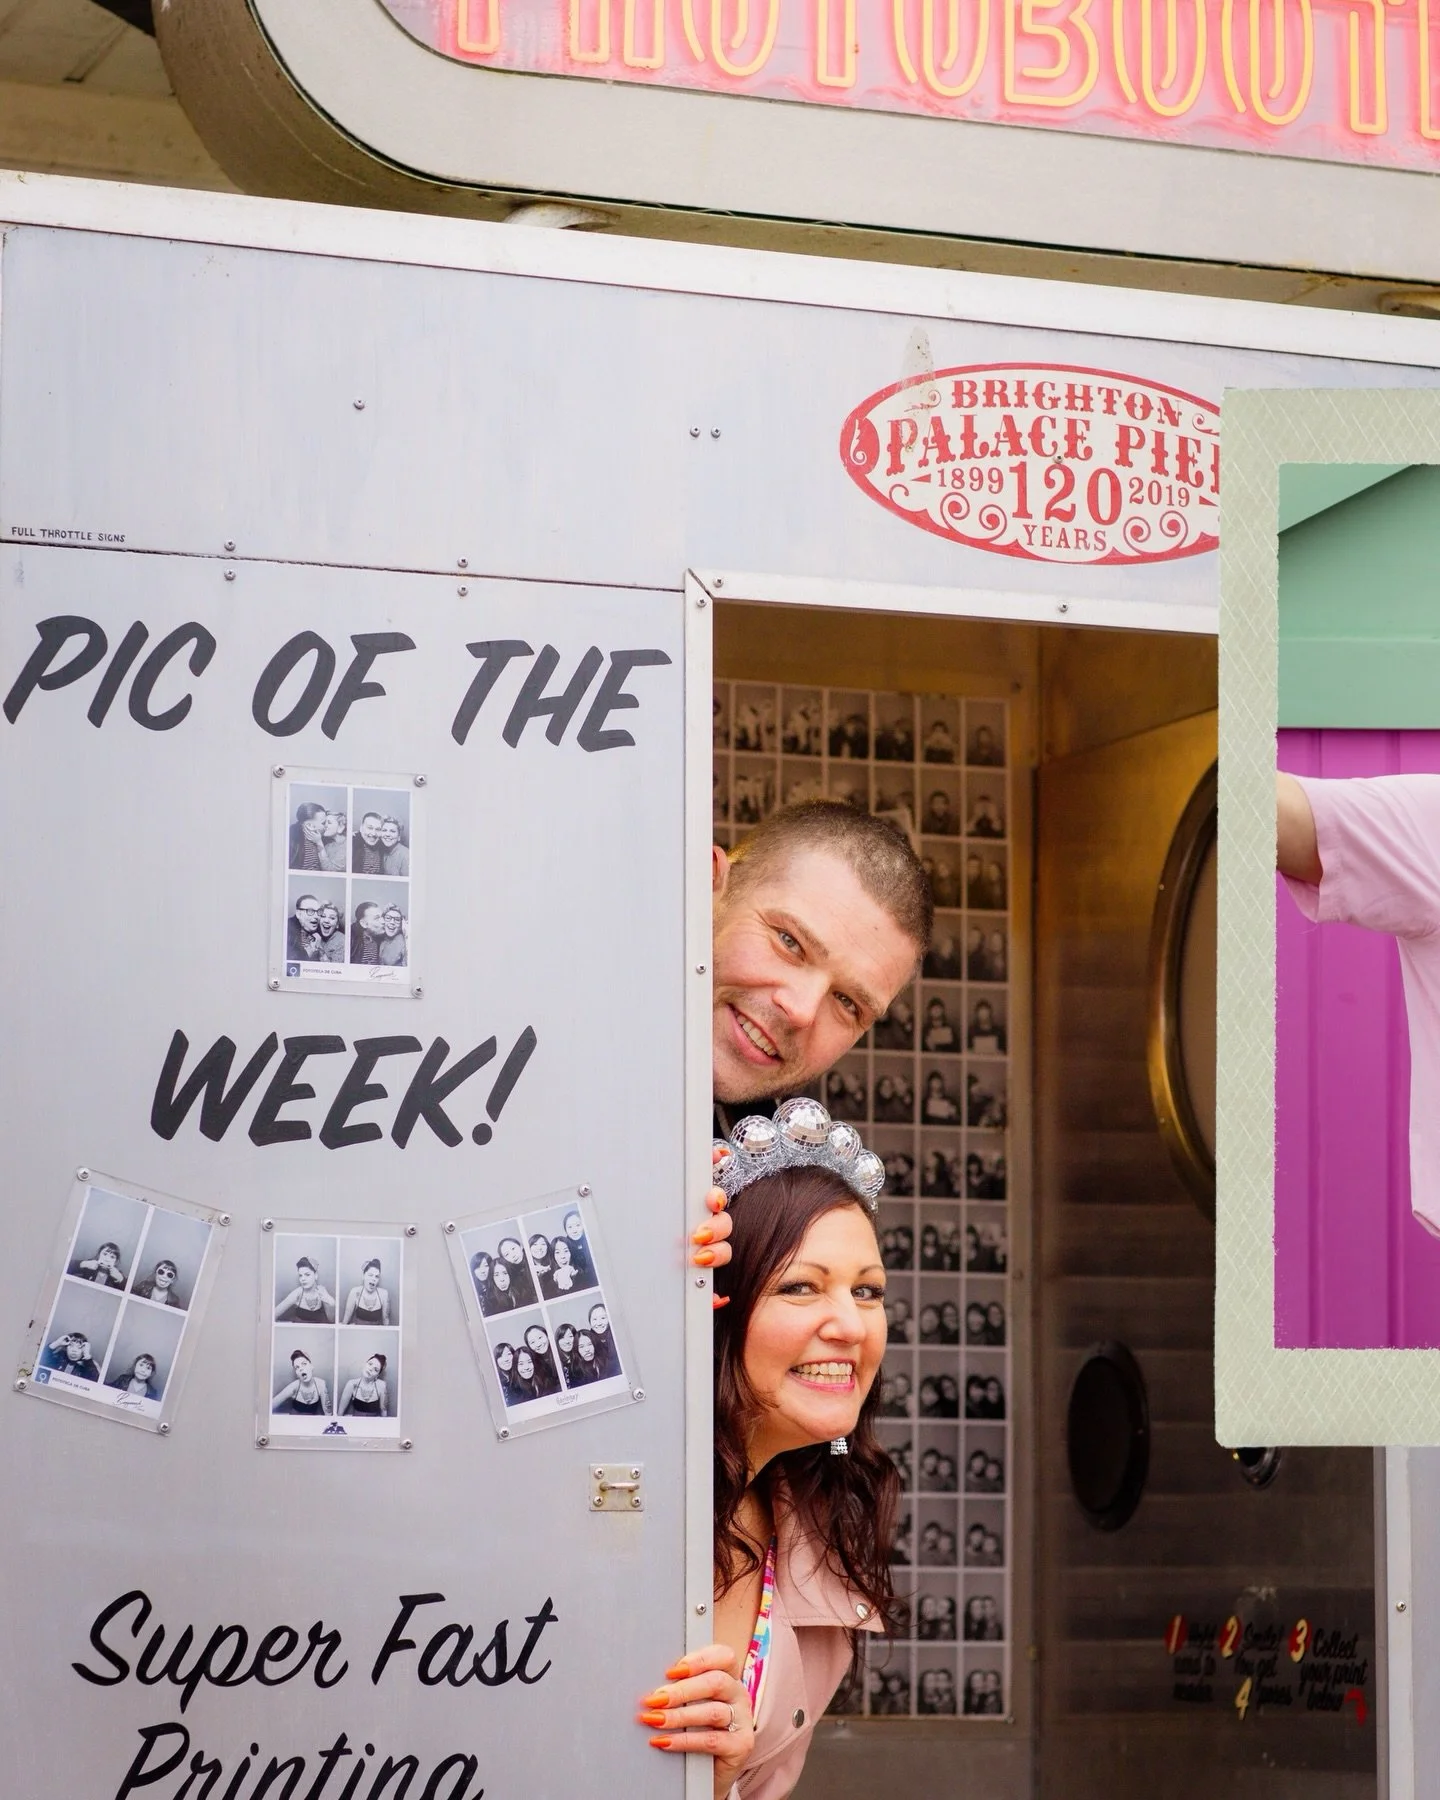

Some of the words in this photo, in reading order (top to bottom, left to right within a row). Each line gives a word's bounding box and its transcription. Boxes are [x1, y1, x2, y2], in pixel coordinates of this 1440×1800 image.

[951, 379, 1183, 427] BRIGHTON
[886, 414, 1094, 477] PALACE
[937, 467, 1004, 494] 1899
[1008, 461, 1123, 526] 120
[1129, 477, 1191, 507] 2019
[11, 526, 36, 537] FULL
[39, 528, 92, 541] THROTTLE
[97, 532, 126, 543] SIGNS
[1023, 524, 1107, 552] YEARS
[3, 615, 217, 731] PIC
[252, 630, 417, 740] OF
[451, 639, 673, 752] THE
[150, 1025, 538, 1151] WEEK!
[71, 1589, 350, 1714] Super
[371, 1592, 559, 1688] Fast
[1289, 1617, 1308, 1663] 3
[1312, 1628, 1359, 1659] Collect
[1332, 1658, 1368, 1689] print
[1234, 1676, 1253, 1721] 4
